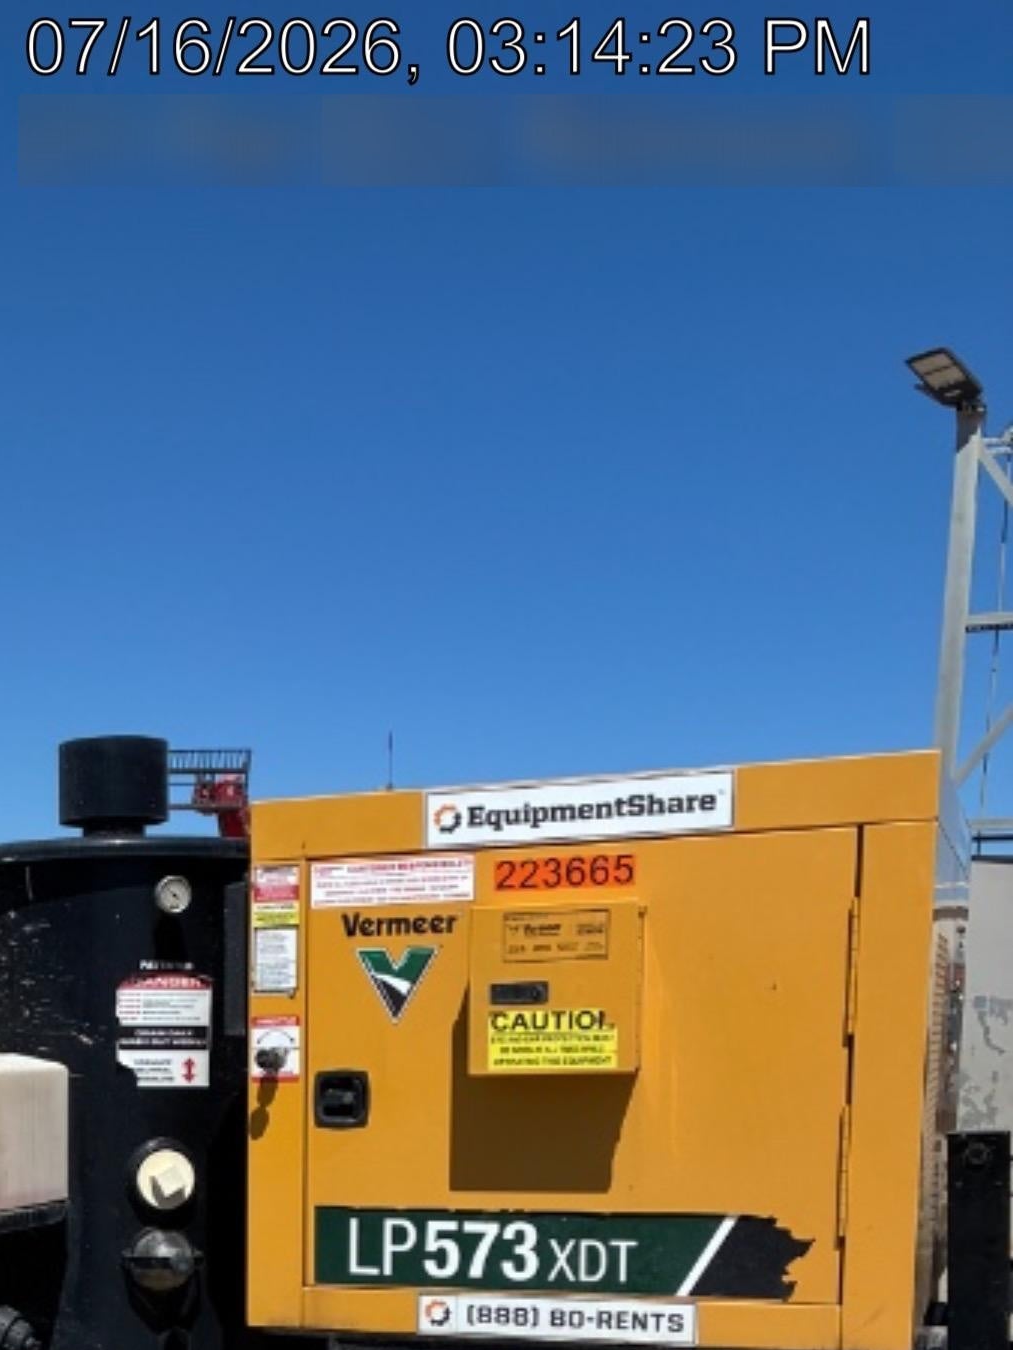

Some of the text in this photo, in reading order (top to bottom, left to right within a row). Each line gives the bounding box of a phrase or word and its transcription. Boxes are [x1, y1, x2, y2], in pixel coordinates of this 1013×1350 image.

[467, 793, 717, 831] EquipmentShare
[494, 855, 635, 890] 223665
[341, 911, 457, 938] Vermeer
[466, 1304, 684, 1333] (888) 80-RENTS
